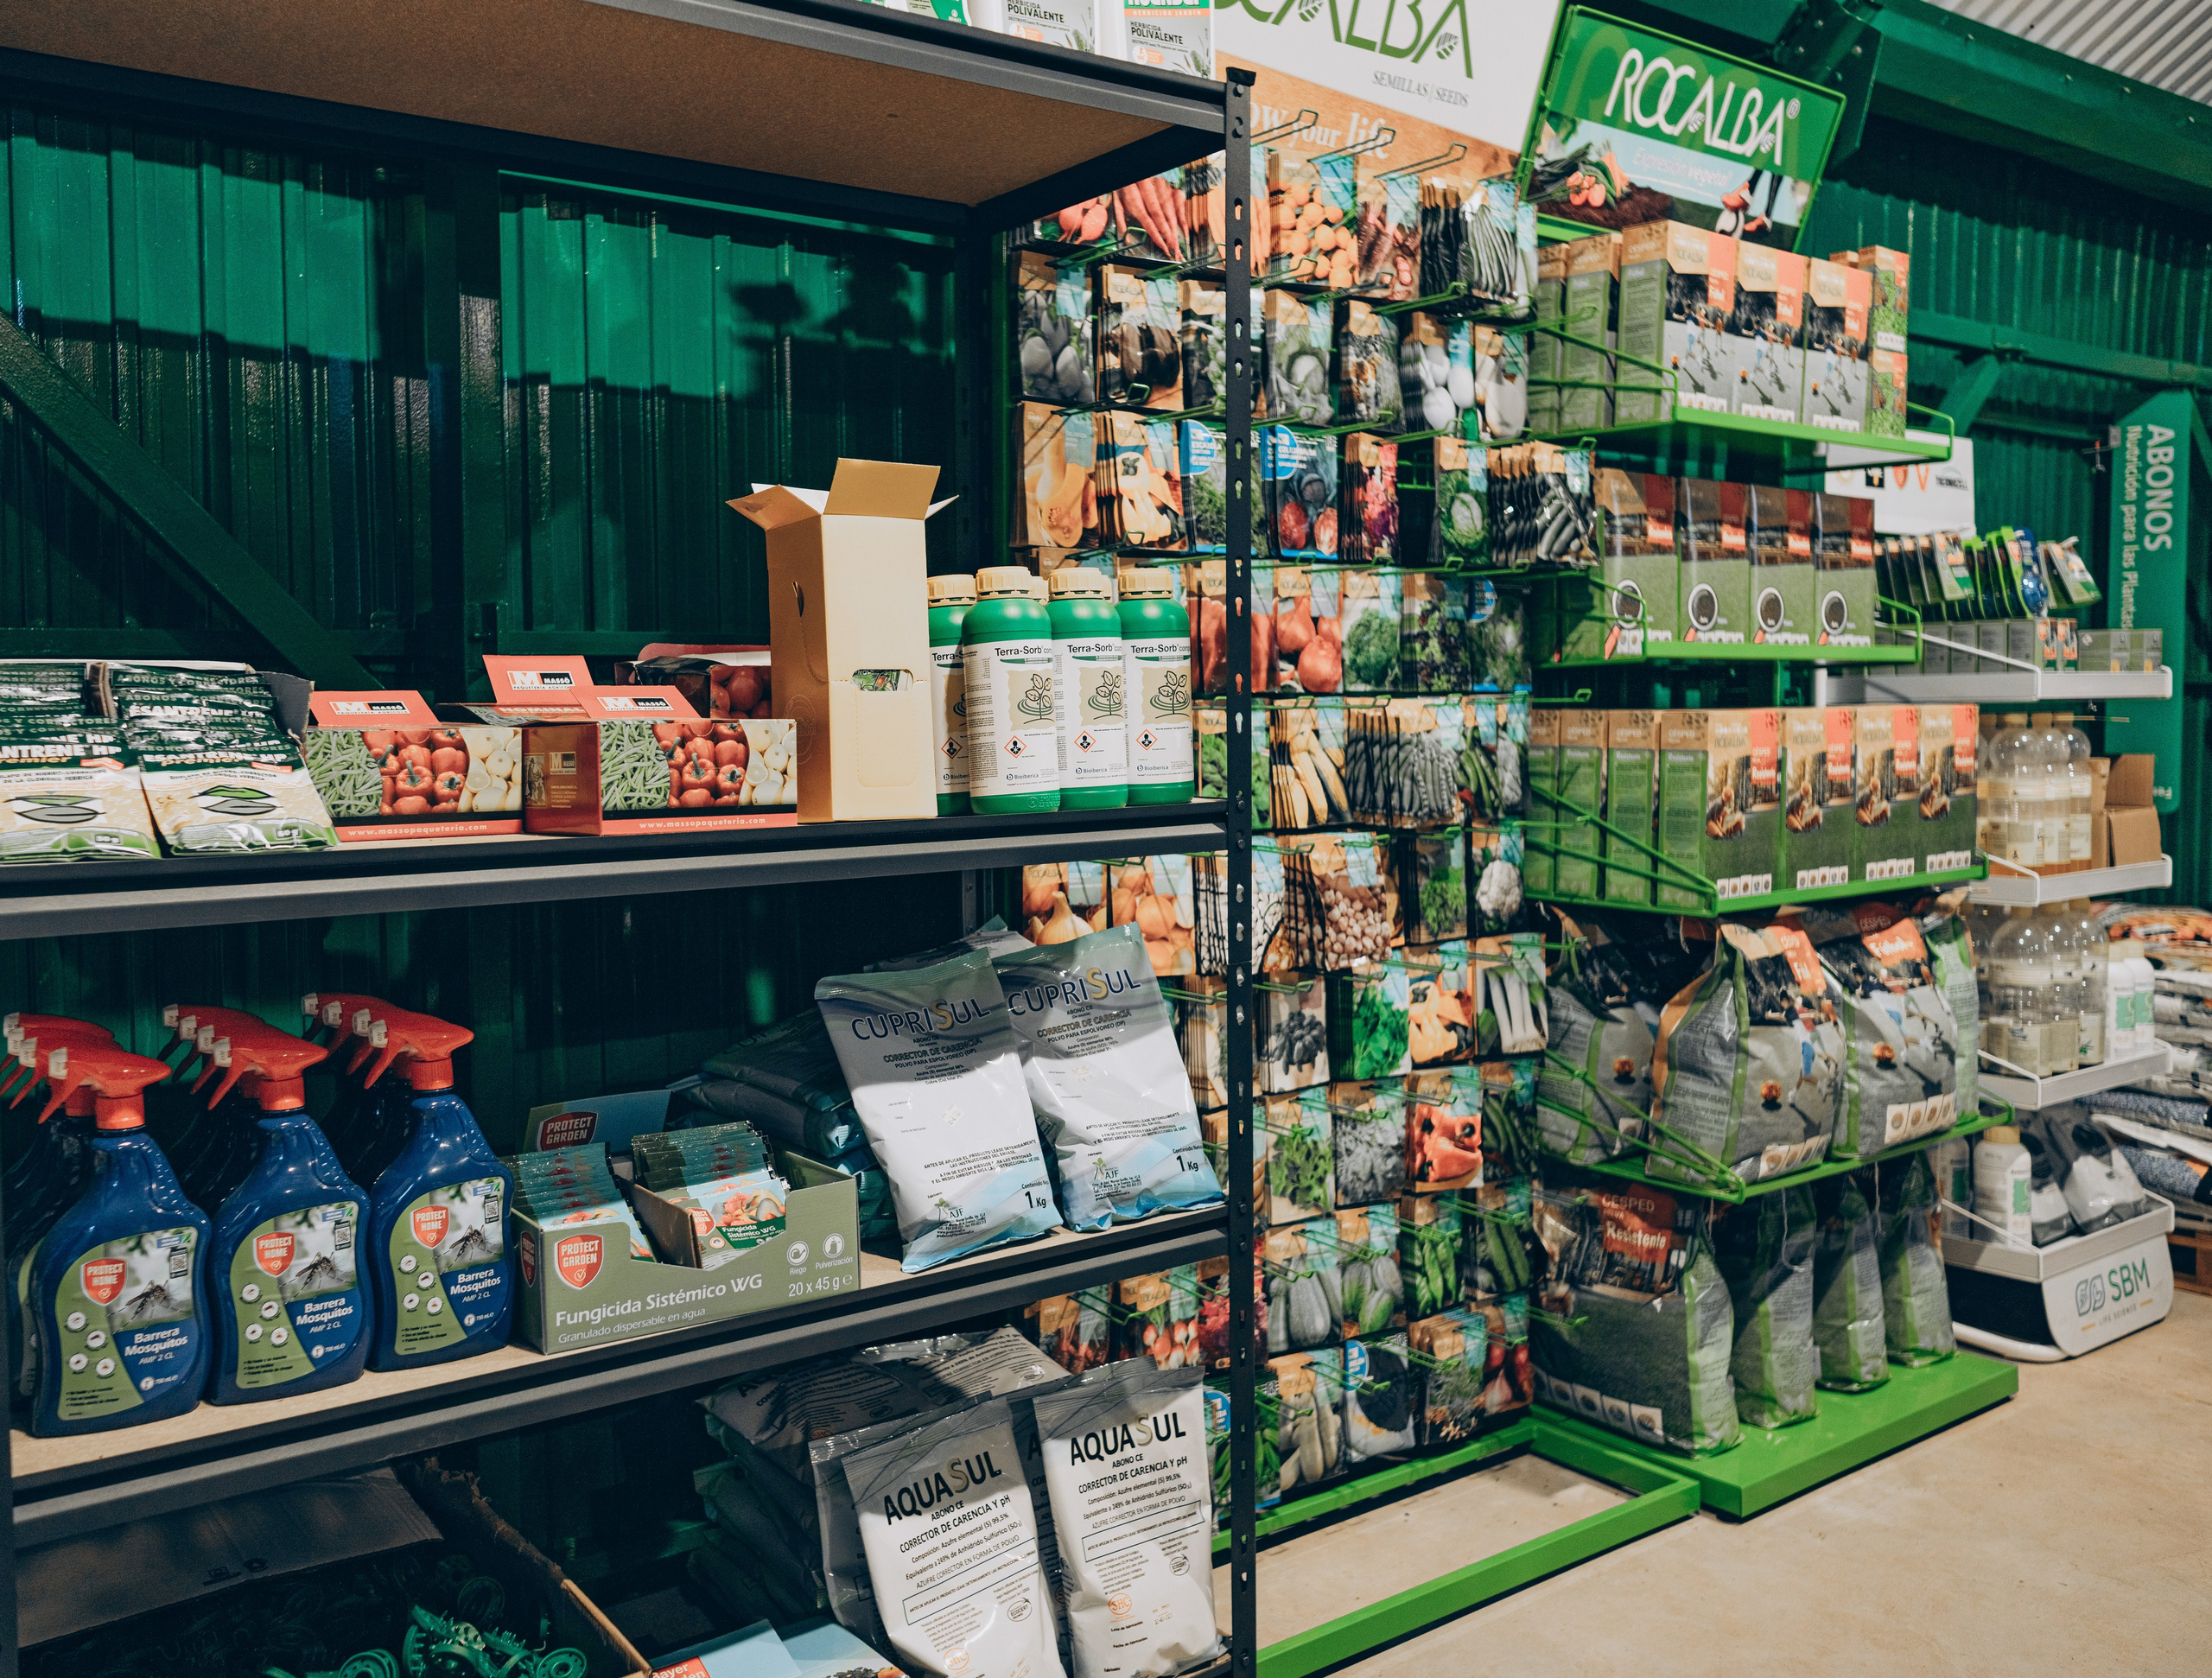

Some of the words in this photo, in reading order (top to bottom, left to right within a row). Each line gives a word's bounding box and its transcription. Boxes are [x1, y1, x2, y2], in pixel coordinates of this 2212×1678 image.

[1008, 3, 1064, 22] POLIVALENTE
[1130, 21, 1161, 31] HERBICIDA
[1132, 27, 1183, 44] POLIVALENTE
[1372, 70, 1427, 97] SEMILLAS
[1434, 88, 1469, 107] SEEDS
[1292, 123, 1341, 146] your
[1347, 112, 1391, 158] life
[2126, 425, 2142, 501] Nutrición
[2144, 424, 2175, 551] ABONOS
[2121, 505, 2136, 542] para
[2123, 545, 2139, 569] las
[932, 650, 963, 661] Terra-S
[347, 823, 487, 837] www.massopaqueteria.com
[639, 817, 766, 829] www.massopaqueteria.com
[1007, 968, 1141, 1016] CUPRISUL
[851, 999, 991, 1040] CUPRISUL
[1066, 1007, 1084, 1016] ABONO
[1037, 1023, 1081, 1038] CORRECTOR
[1094, 1009, 1132, 1024] CARENCIA
[1080, 1023, 1115, 1036] ESPOLVOREO
[883, 1049, 929, 1063] CORRECTOR
[930, 1047, 941, 1056] DE
[942, 1037, 982, 1053] CARENCIA
[930, 1052, 963, 1064] ESPOLVOREO
[547, 1116, 593, 1133] PROTECT
[546, 1129, 588, 1145] GARDEN
[1176, 1155, 1185, 1172] 1
[1187, 1161, 1198, 1172] Kg
[1105, 1170, 1119, 1179] AJF
[1025, 1191, 1033, 1209] 1
[1036, 1197, 1046, 1209] Kg
[416, 1210, 446, 1222] PROTECT
[950, 1208, 963, 1218] AJF
[422, 1219, 442, 1231] HOME
[728, 1230, 760, 1238] Sistémico
[259, 1236, 292, 1250] PROTECT
[1606, 1220, 1666, 1249] Resistente
[264, 1248, 288, 1259] HOME
[562, 1240, 600, 1255] PROTECT
[86, 1263, 124, 1276] PROTECT
[563, 1253, 597, 1268] GARDEN
[815, 1256, 853, 1270] Pulverización
[458, 1268, 494, 1283] Barrera
[790, 1267, 807, 1275] Riego
[2108, 1257, 2150, 1302] SBM
[92, 1275, 118, 1287] HOME
[450, 1276, 501, 1295] Mosquitos
[789, 1281, 803, 1297] 20
[806, 1282, 813, 1293] x
[815, 1275, 830, 1291] 45
[833, 1275, 840, 1291] g
[304, 1298, 346, 1313] Barrera
[556, 1299, 642, 1326] Fungicida
[645, 1283, 727, 1310] Sistémico
[730, 1274, 762, 1293] WG
[296, 1306, 353, 1325] Mosquitos
[2098, 1314, 2112, 1327] LIFE
[2113, 1305, 2138, 1321] SCIENCE
[558, 1326, 611, 1344] Granulado
[613, 1315, 665, 1332] dispersable
[668, 1313, 680, 1322] en
[682, 1307, 706, 1321] agua
[134, 1327, 181, 1344] Barrera
[124, 1337, 188, 1357] Mosquitos
[1071, 1412, 1186, 1466] AQUASUL
[1112, 1456, 1135, 1469] ABONO
[1135, 1453, 1144, 1462] CE
[1078, 1474, 1118, 1494] CORRECTOR
[1120, 1471, 1129, 1481] DE
[1130, 1460, 1168, 1478] CARENCIA
[1170, 1459, 1175, 1467] Y
[1177, 1456, 1187, 1467] pH
[883, 1451, 1002, 1525] AQUASUL
[1088, 1492, 1117, 1506] Composición:
[1118, 1487, 1132, 1496] Azufre
[1134, 1479, 1157, 1491] elemental
[931, 1505, 955, 1522] ABONO
[956, 1500, 964, 1510] CE
[1092, 1517, 1109, 1529] AZUFRE
[1109, 1510, 1136, 1523] CORRECTOR
[1169, 1496, 1185, 1505] POLVO
[899, 1527, 940, 1554] CORRECTOR
[940, 1521, 951, 1534] DE
[953, 1503, 993, 1528] CARENCIA
[992, 1499, 1000, 1509] Y
[1000, 1495, 1011, 1507] pH
[912, 1545, 941, 1564] Composición:
[941, 1536, 958, 1549] Azufre
[957, 1524, 984, 1541] elemental
[983, 1520, 992, 1530] (S)
[991, 1512, 1009, 1526] 99,5%
[906, 1564, 933, 1580] Equivalente
[957, 1539, 984, 1554] Anhídrido
[984, 1528, 1007, 1541] Sulfúrico
[916, 1574, 936, 1589] AZUFRE
[937, 1560, 964, 1579] CORRECTOR
[973, 1548, 993, 1563] FORMA
[993, 1543, 1001, 1552] DE
[1001, 1535, 1020, 1547] POLVO
[1010, 1605, 1028, 1618] ECOCERT
[1110, 1598, 1131, 1611] SHC
